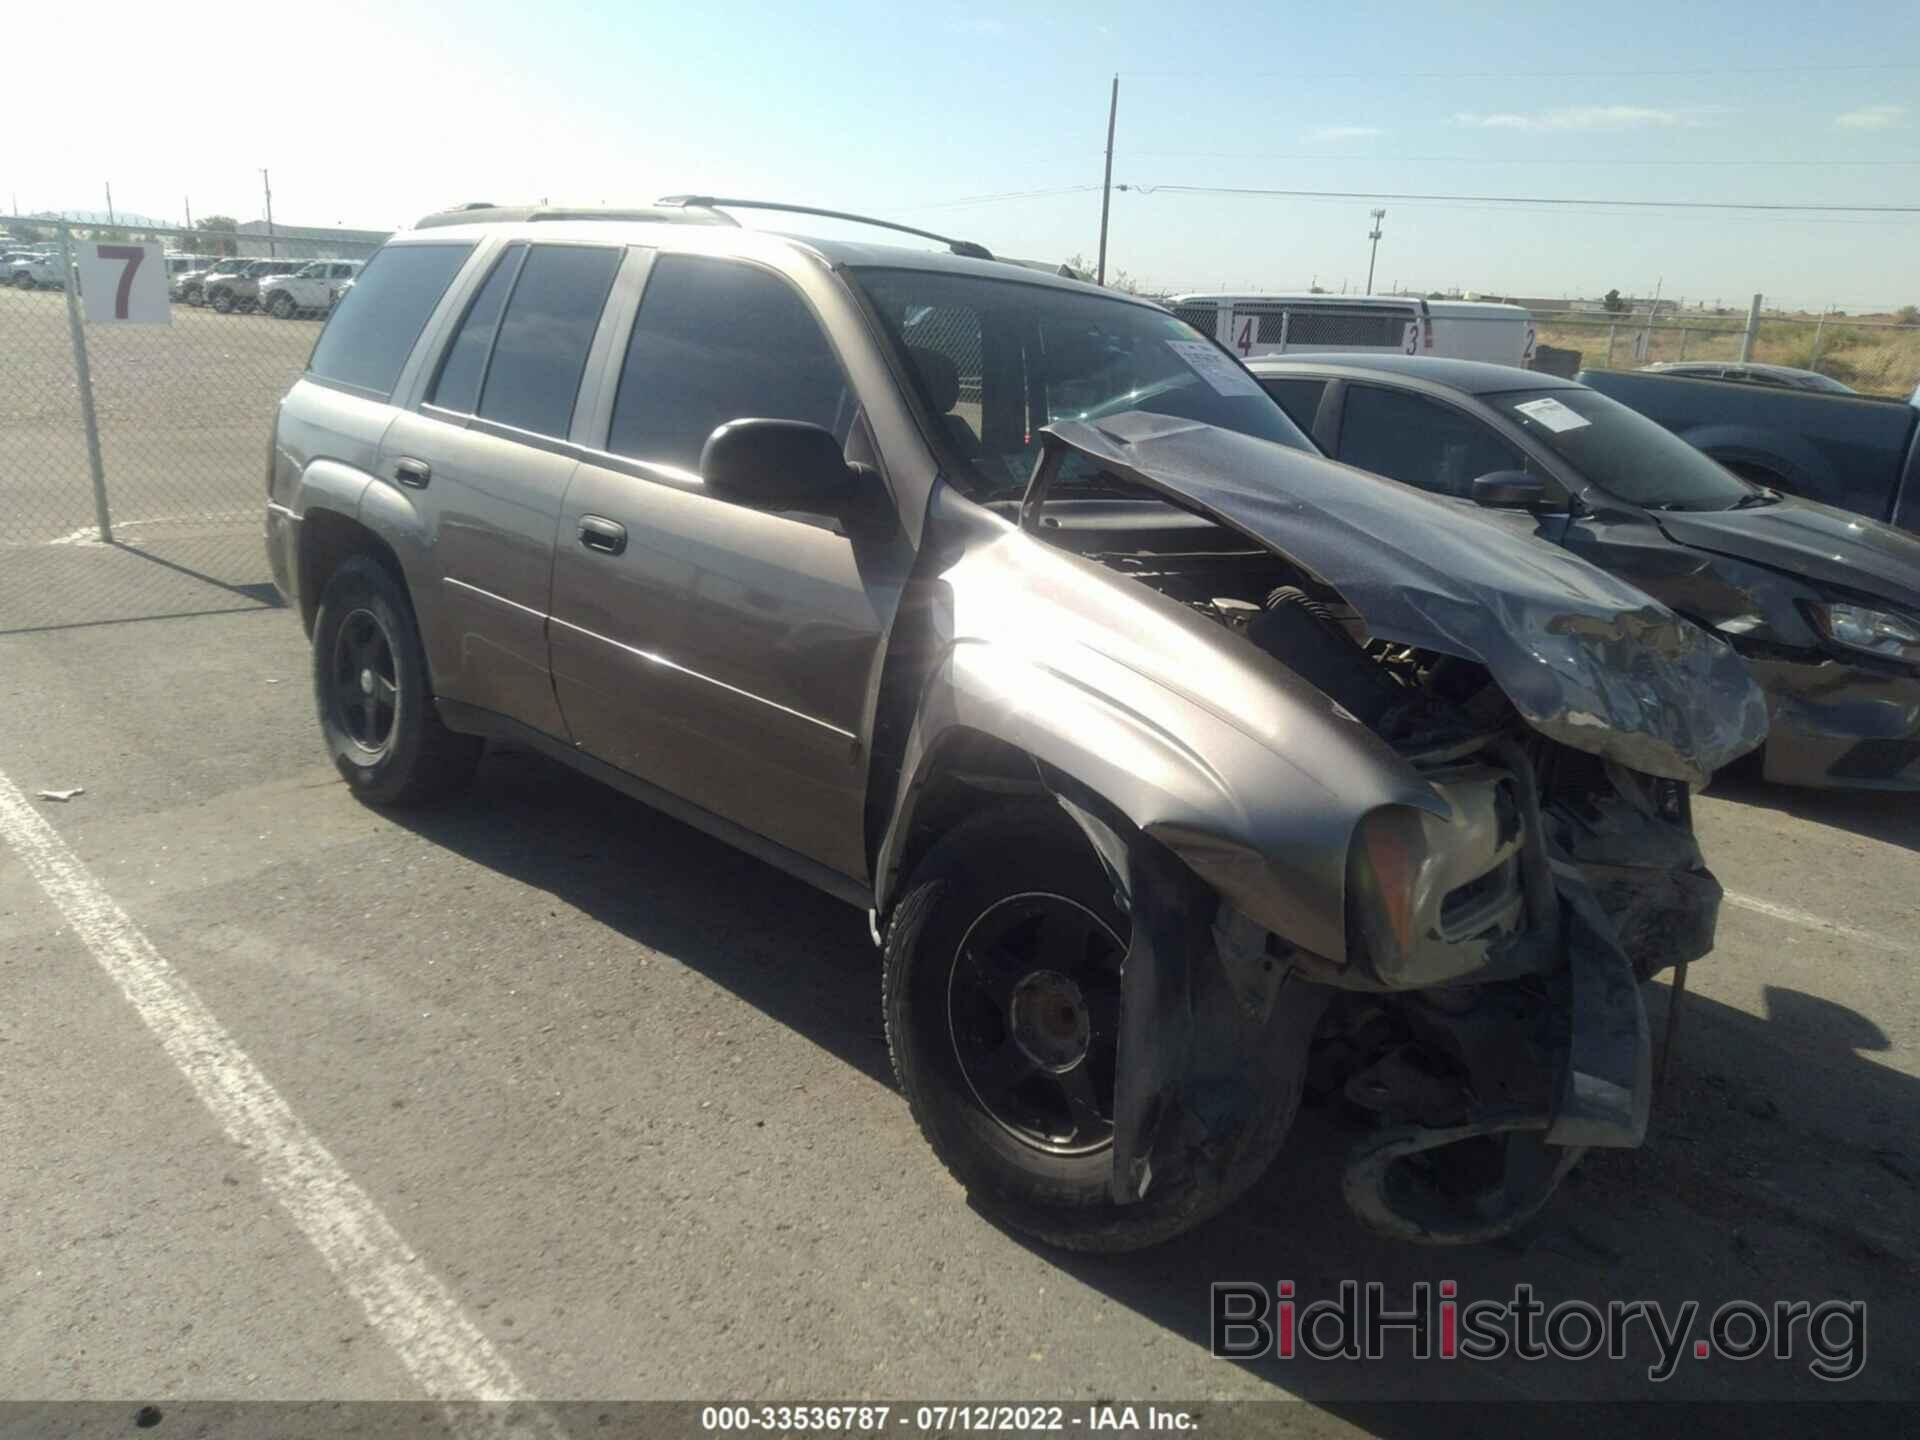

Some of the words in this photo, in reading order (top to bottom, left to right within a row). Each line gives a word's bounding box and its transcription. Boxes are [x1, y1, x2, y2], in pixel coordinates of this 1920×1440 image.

[97, 244, 145, 320] 7
[1237, 318, 1252, 357] 4
[1406, 326, 1419, 355] 3
[1523, 329, 1535, 358] 2
